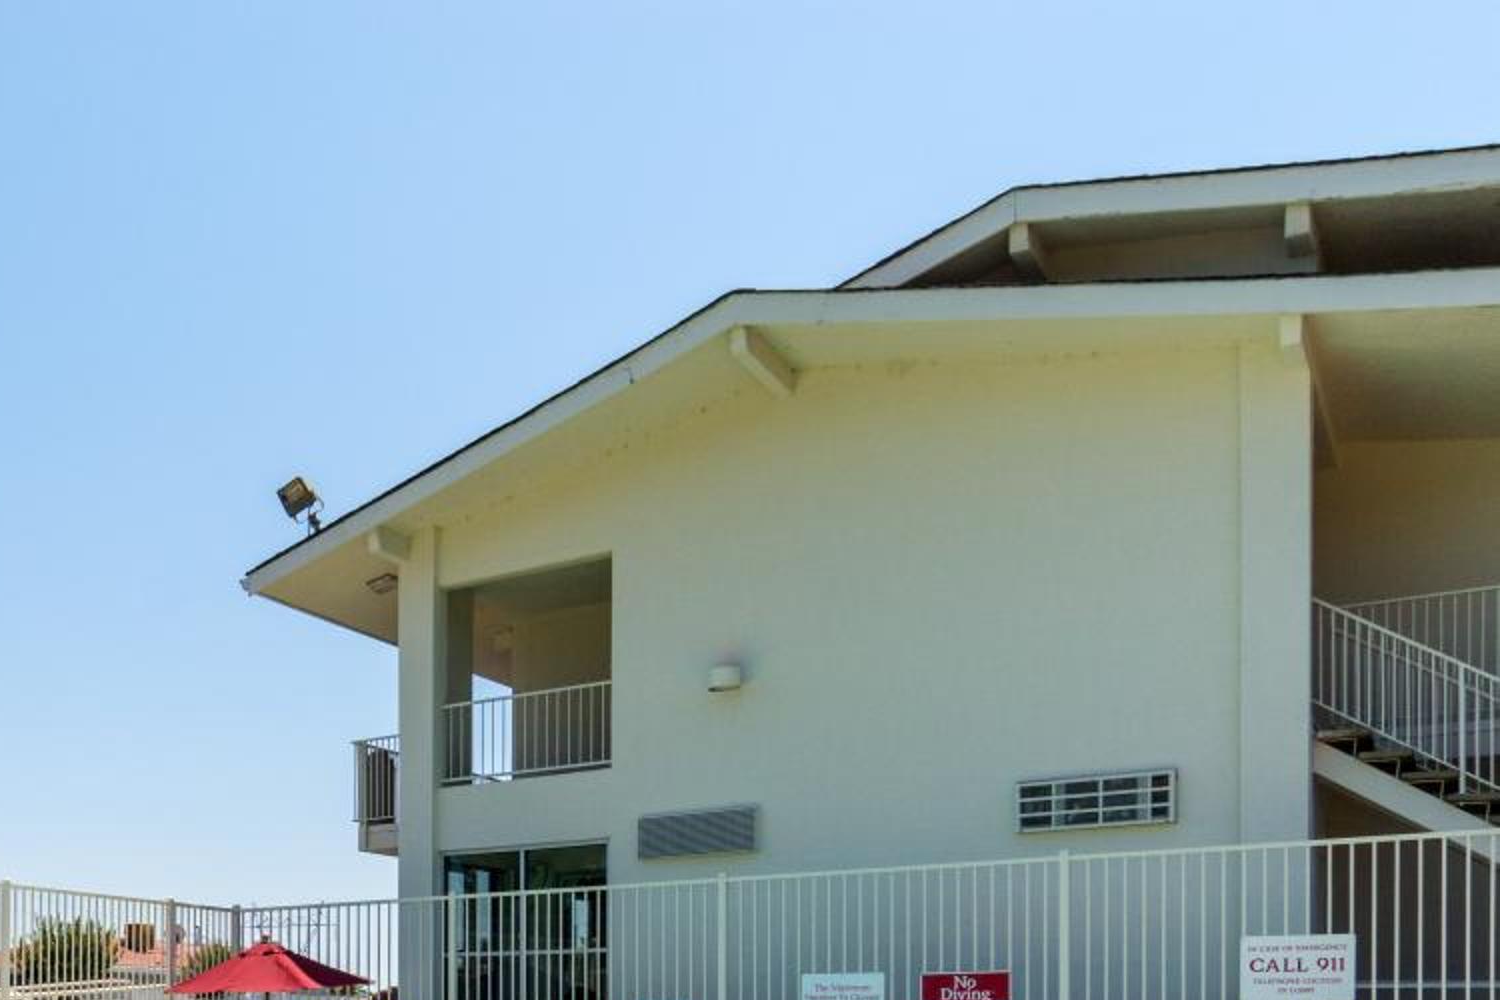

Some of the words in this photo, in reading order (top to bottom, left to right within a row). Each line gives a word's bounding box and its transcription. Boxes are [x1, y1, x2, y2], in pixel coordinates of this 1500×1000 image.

[1249, 957, 1309, 972] CALL
[1317, 957, 1345, 971] 911
[953, 975, 977, 989] No
